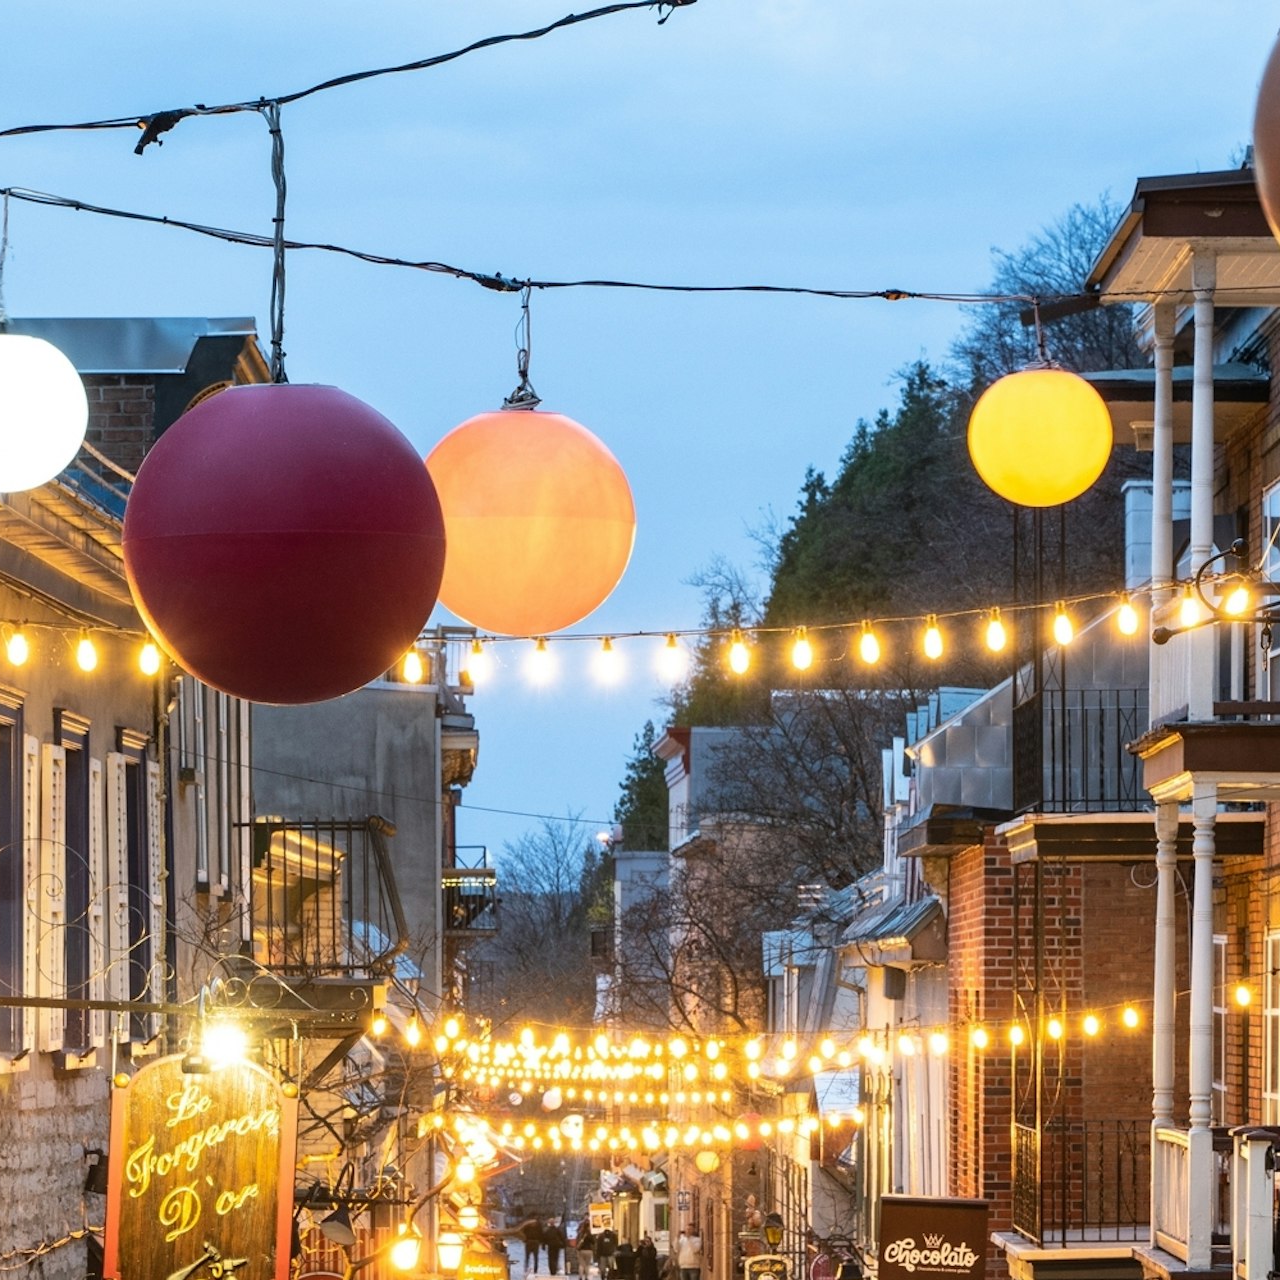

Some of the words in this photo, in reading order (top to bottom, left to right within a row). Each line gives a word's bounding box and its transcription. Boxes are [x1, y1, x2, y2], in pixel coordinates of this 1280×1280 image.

[166, 1085, 212, 1127] Le
[126, 1108, 280, 1198] Forgeron
[884, 1238, 980, 1272] Chocolato
